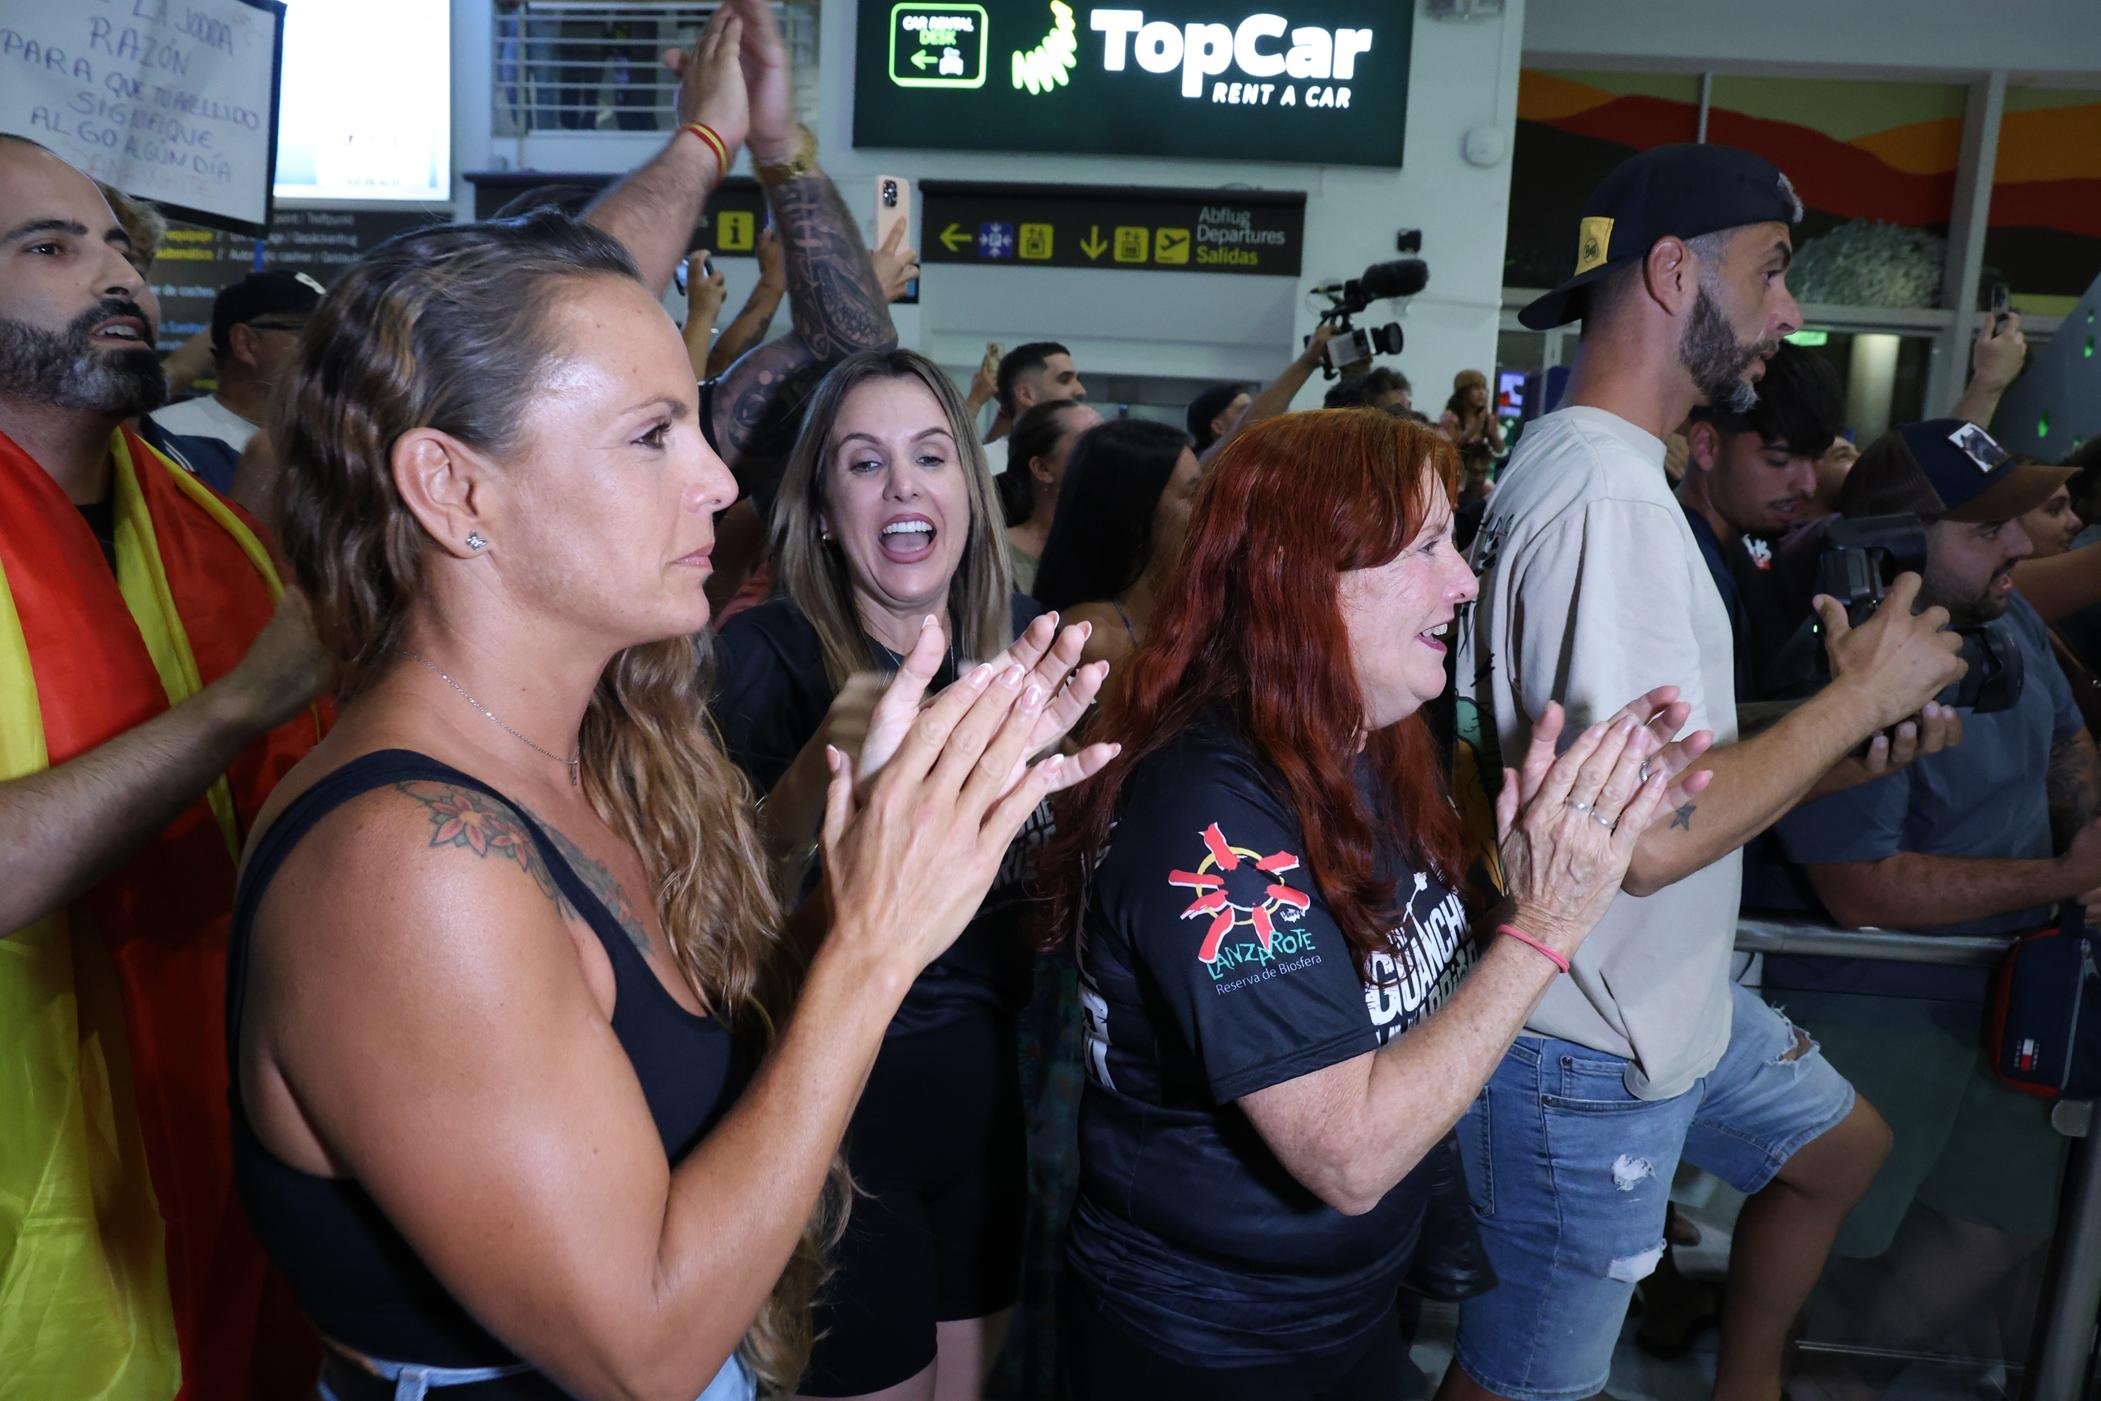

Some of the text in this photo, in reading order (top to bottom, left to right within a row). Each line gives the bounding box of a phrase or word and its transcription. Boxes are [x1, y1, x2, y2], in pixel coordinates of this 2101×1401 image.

[1, 27, 93, 83] PARA
[88, 16, 192, 77] RAZÓN
[1089, 8, 1374, 98] TopCar
[1212, 81, 1352, 109] RENT A CAR
[193, 153, 233, 184] DÍA
[1196, 222, 1286, 246] Departures
[1199, 206, 1251, 231] Abflug
[1196, 244, 1259, 267] Salidas
[1206, 928, 1317, 980] LANZAROTE
[1215, 954, 1322, 996] Reserva de Biosfera
